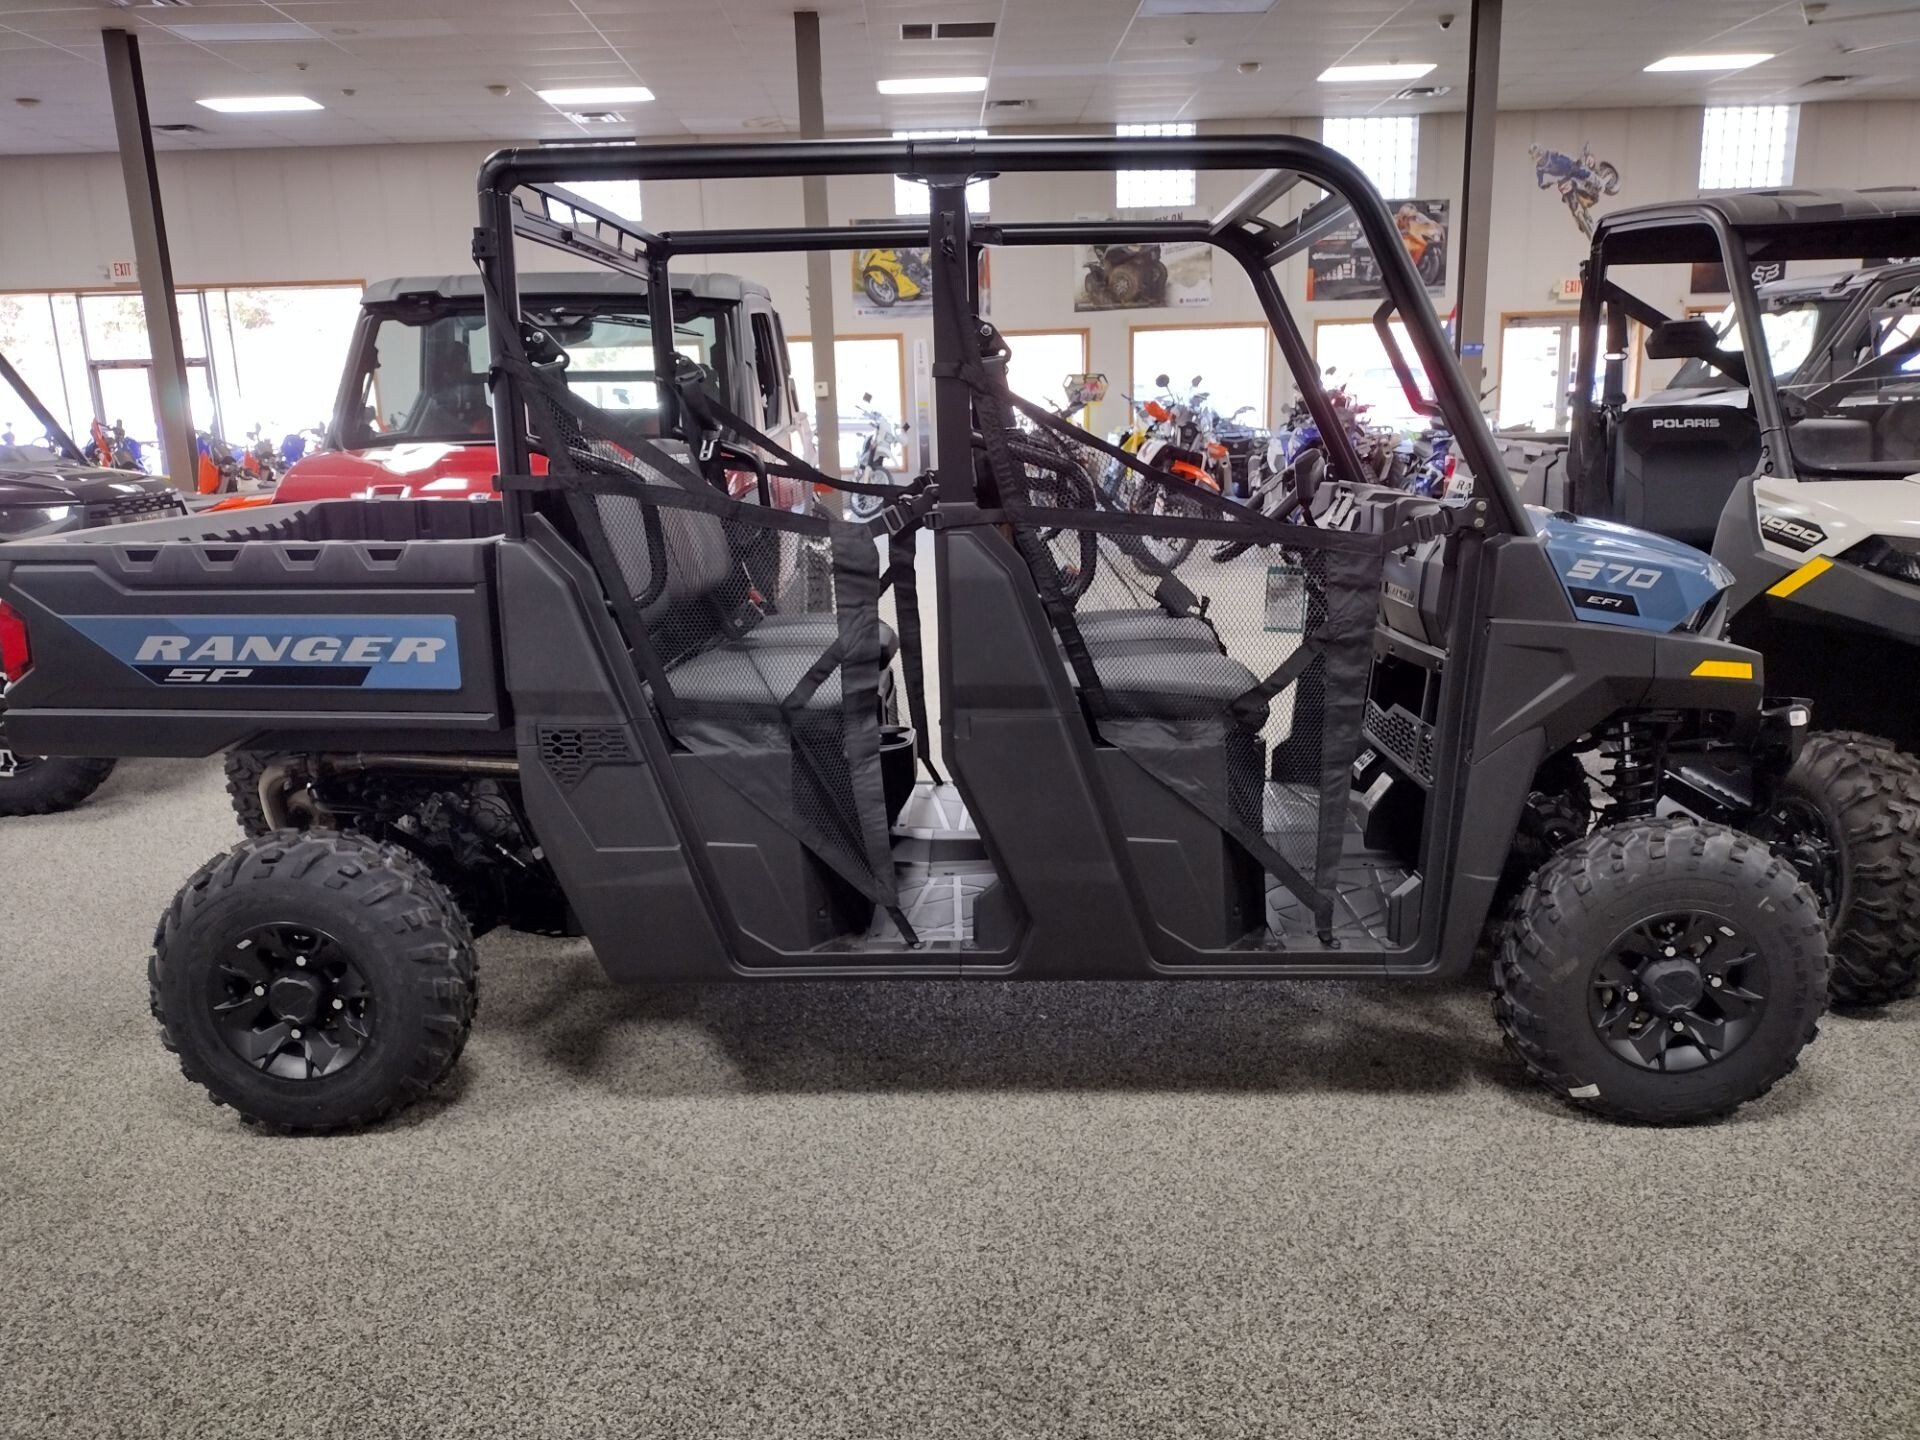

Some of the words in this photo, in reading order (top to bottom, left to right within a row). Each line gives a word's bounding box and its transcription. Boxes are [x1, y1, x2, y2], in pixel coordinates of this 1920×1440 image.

[113, 262, 131, 277] EXIT
[1652, 418, 1720, 429] POLARIS
[1760, 514, 1824, 543] 1000
[1566, 559, 1663, 589] 570
[1586, 595, 1623, 608] EFI
[134, 635, 446, 663] RANGER
[163, 668, 253, 682] SP
